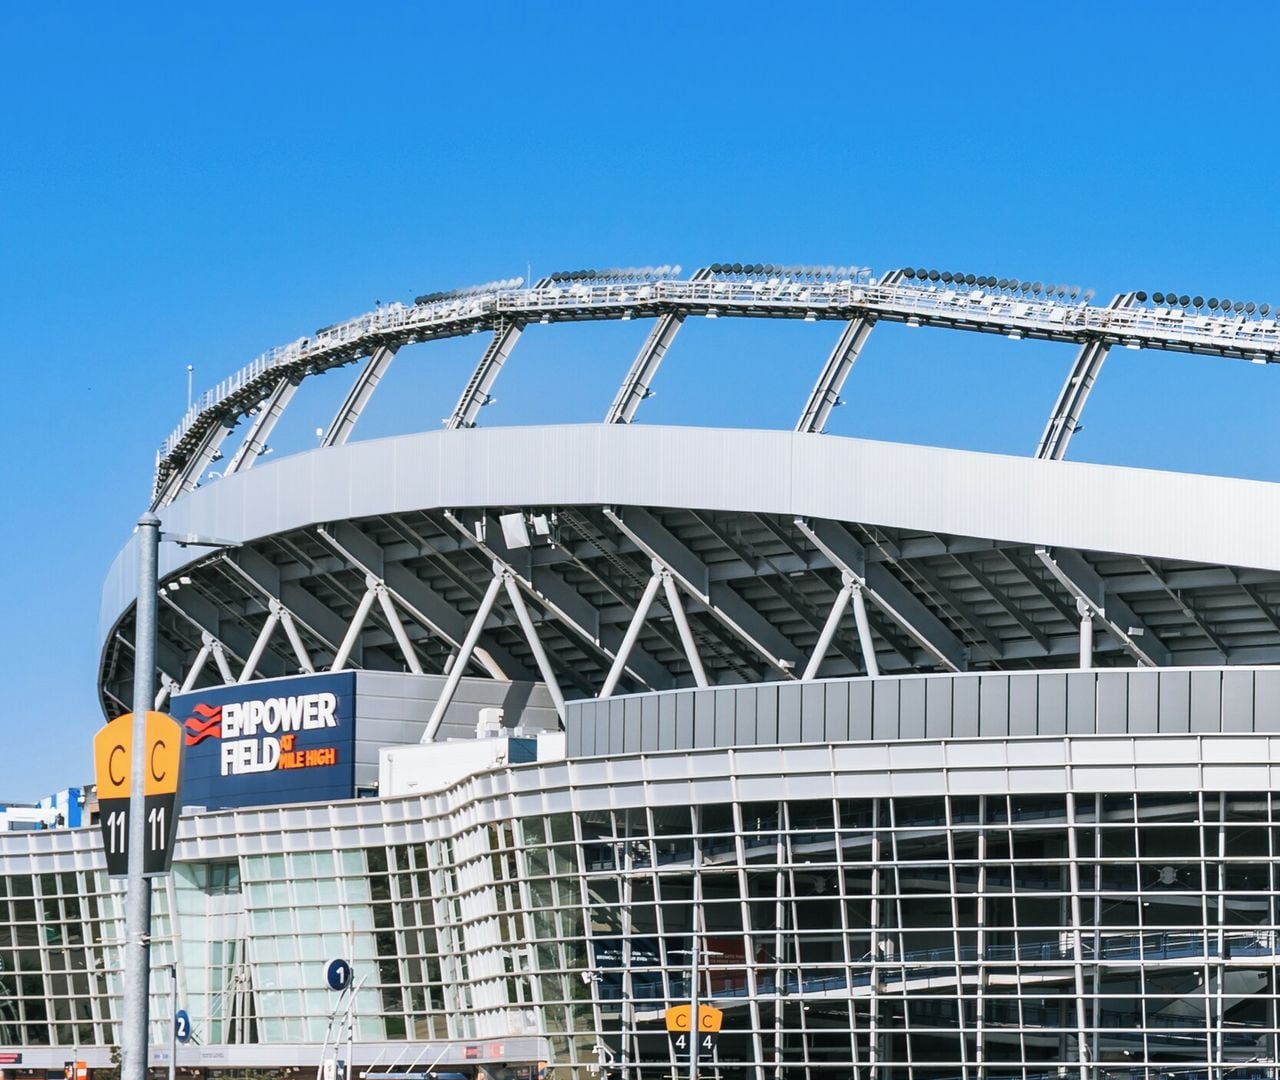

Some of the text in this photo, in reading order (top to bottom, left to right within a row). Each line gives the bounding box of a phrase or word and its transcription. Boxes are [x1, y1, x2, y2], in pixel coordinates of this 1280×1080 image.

[221, 692, 336, 739] EMPOWER
[280, 735, 296, 751] AT
[109, 745, 126, 786] C
[151, 740, 166, 782] C
[220, 737, 280, 776] FIELD
[279, 748, 336, 770] MILE HIGH
[107, 811, 126, 853] 11
[149, 807, 165, 850] 11
[336, 967, 344, 984] 1
[178, 1017, 186, 1036] 2
[676, 1014, 687, 1028] C
[702, 1015, 712, 1028] C
[676, 1035, 686, 1049] 4
[702, 1035, 713, 1049] 4
